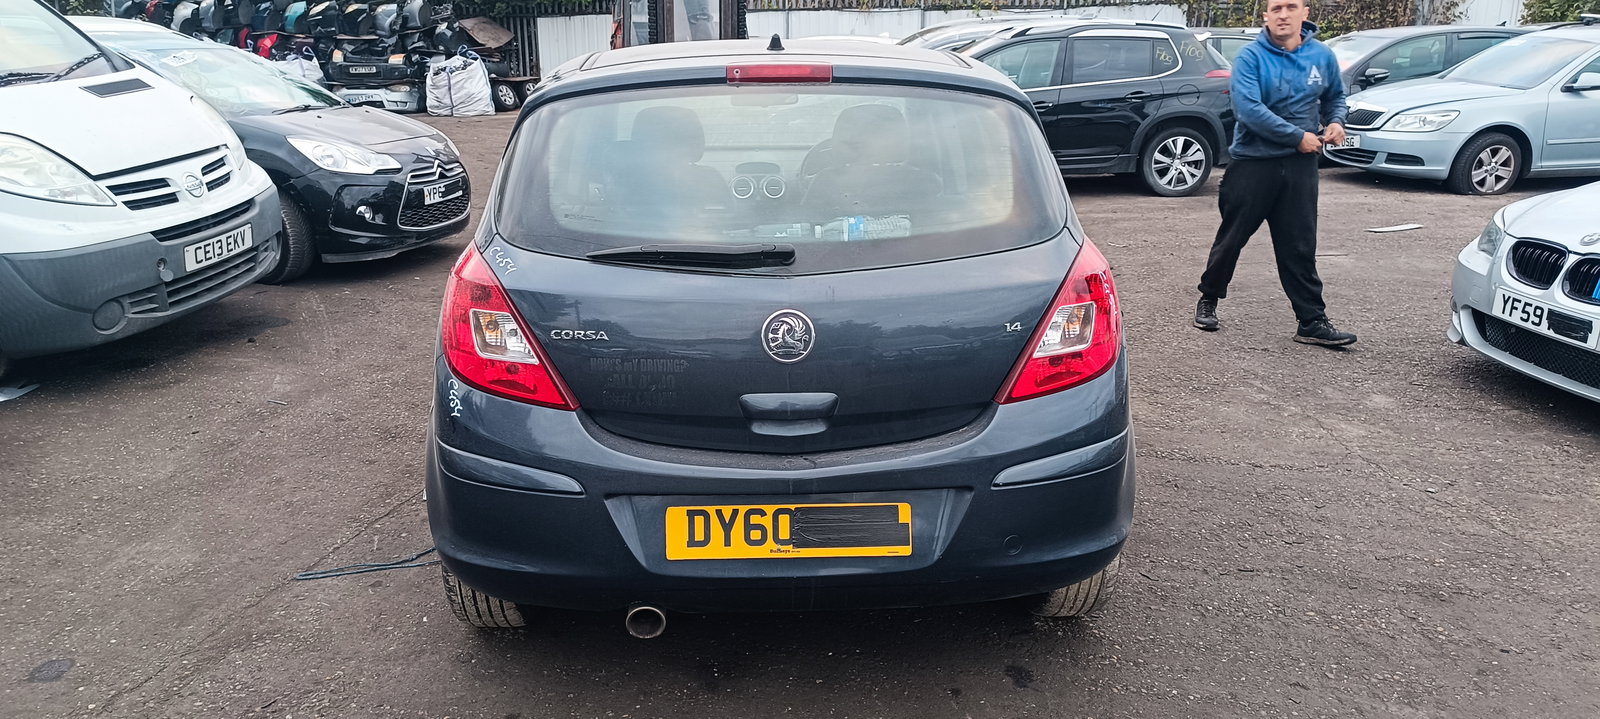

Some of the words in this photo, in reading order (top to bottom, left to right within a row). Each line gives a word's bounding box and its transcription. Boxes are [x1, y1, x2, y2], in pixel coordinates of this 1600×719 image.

[1307, 65, 1322, 85] A
[194, 239, 223, 264] CE13
[226, 229, 246, 253] EKV
[1502, 293, 1545, 327] YF59
[550, 329, 610, 341] CORSA
[686, 507, 794, 548] DY60
